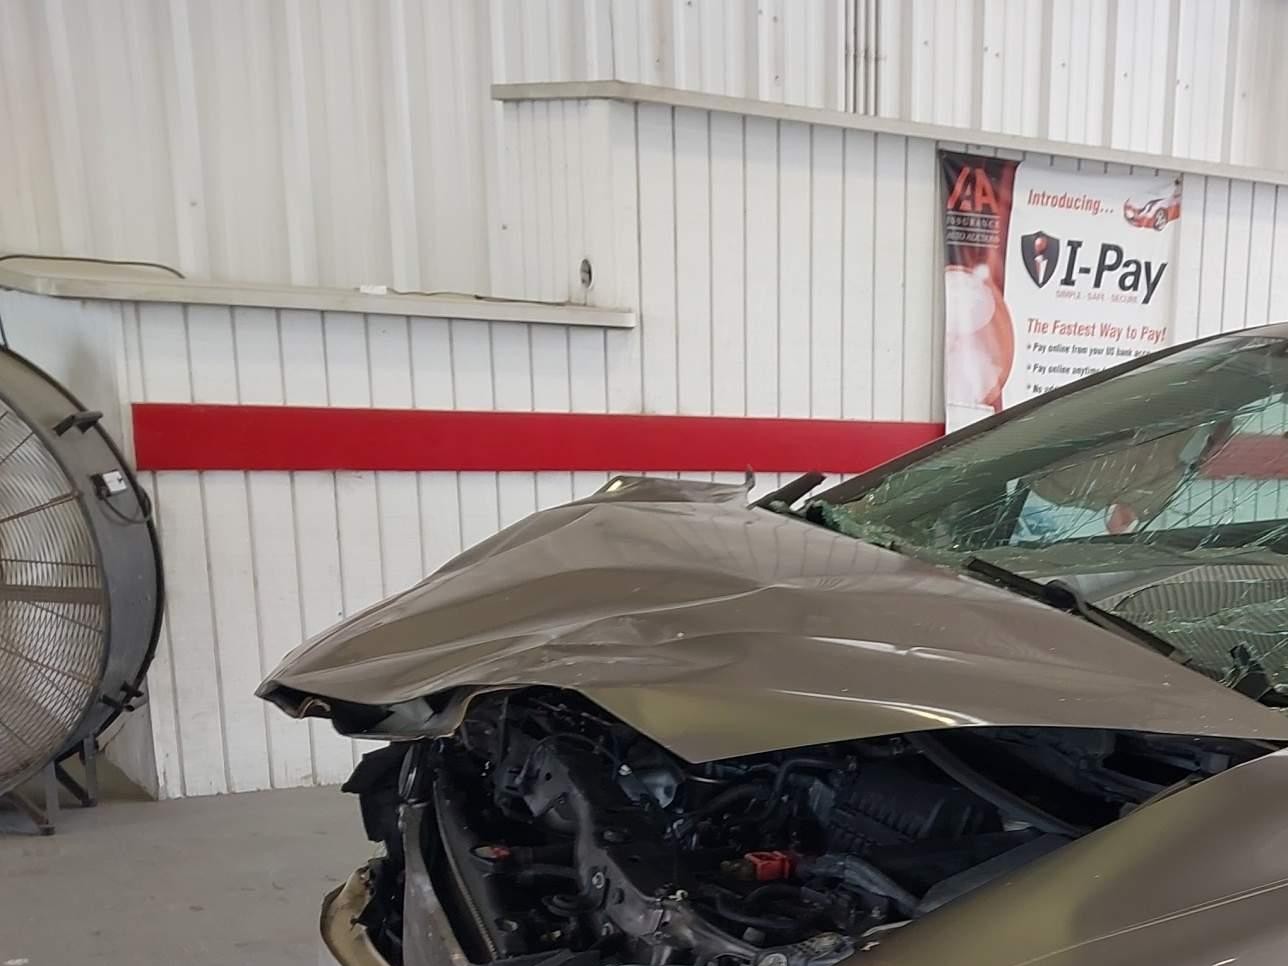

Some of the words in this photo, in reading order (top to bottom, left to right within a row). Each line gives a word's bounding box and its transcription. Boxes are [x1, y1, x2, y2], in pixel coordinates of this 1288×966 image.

[1027, 189, 1114, 215] Introducing...
[1059, 239, 1168, 304] I-Pay
[1027, 317, 1049, 335] The
[1052, 319, 1097, 337] Fastest
[1099, 322, 1123, 342] Way
[1126, 324, 1138, 340] to
[1140, 325, 1168, 344] Pay!
[1032, 341, 1047, 354] Pay
[1048, 343, 1070, 354] online
[1071, 344, 1088, 354] from
[1088, 346, 1105, 357] your
[1032, 362, 1047, 375] Pay
[1048, 364, 1071, 375] online
